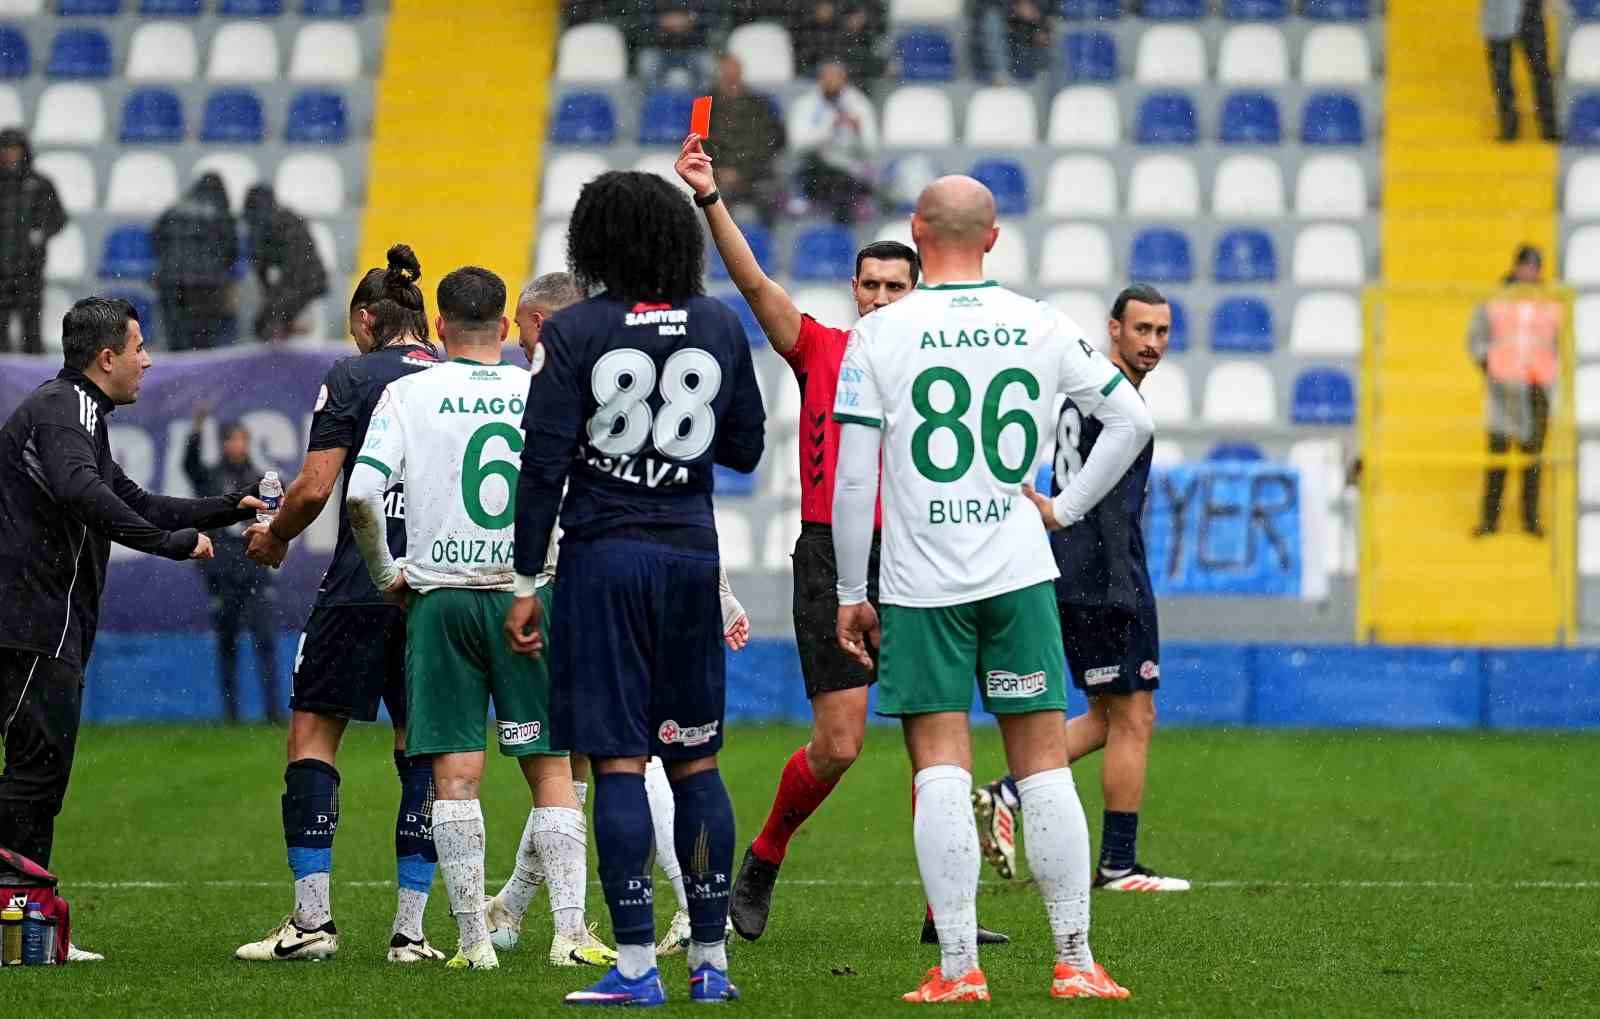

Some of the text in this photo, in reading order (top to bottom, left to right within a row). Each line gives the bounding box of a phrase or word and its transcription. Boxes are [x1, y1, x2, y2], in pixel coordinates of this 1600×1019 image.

[920, 322, 1028, 349] ALAGÖZ
[439, 393, 525, 414] ALAGÖ
[586, 348, 722, 461] 88
[911, 366, 1041, 484] 86
[462, 422, 525, 530] 6
[929, 499, 1012, 524] BURAK
[432, 536, 515, 563] OĞUZ KA
